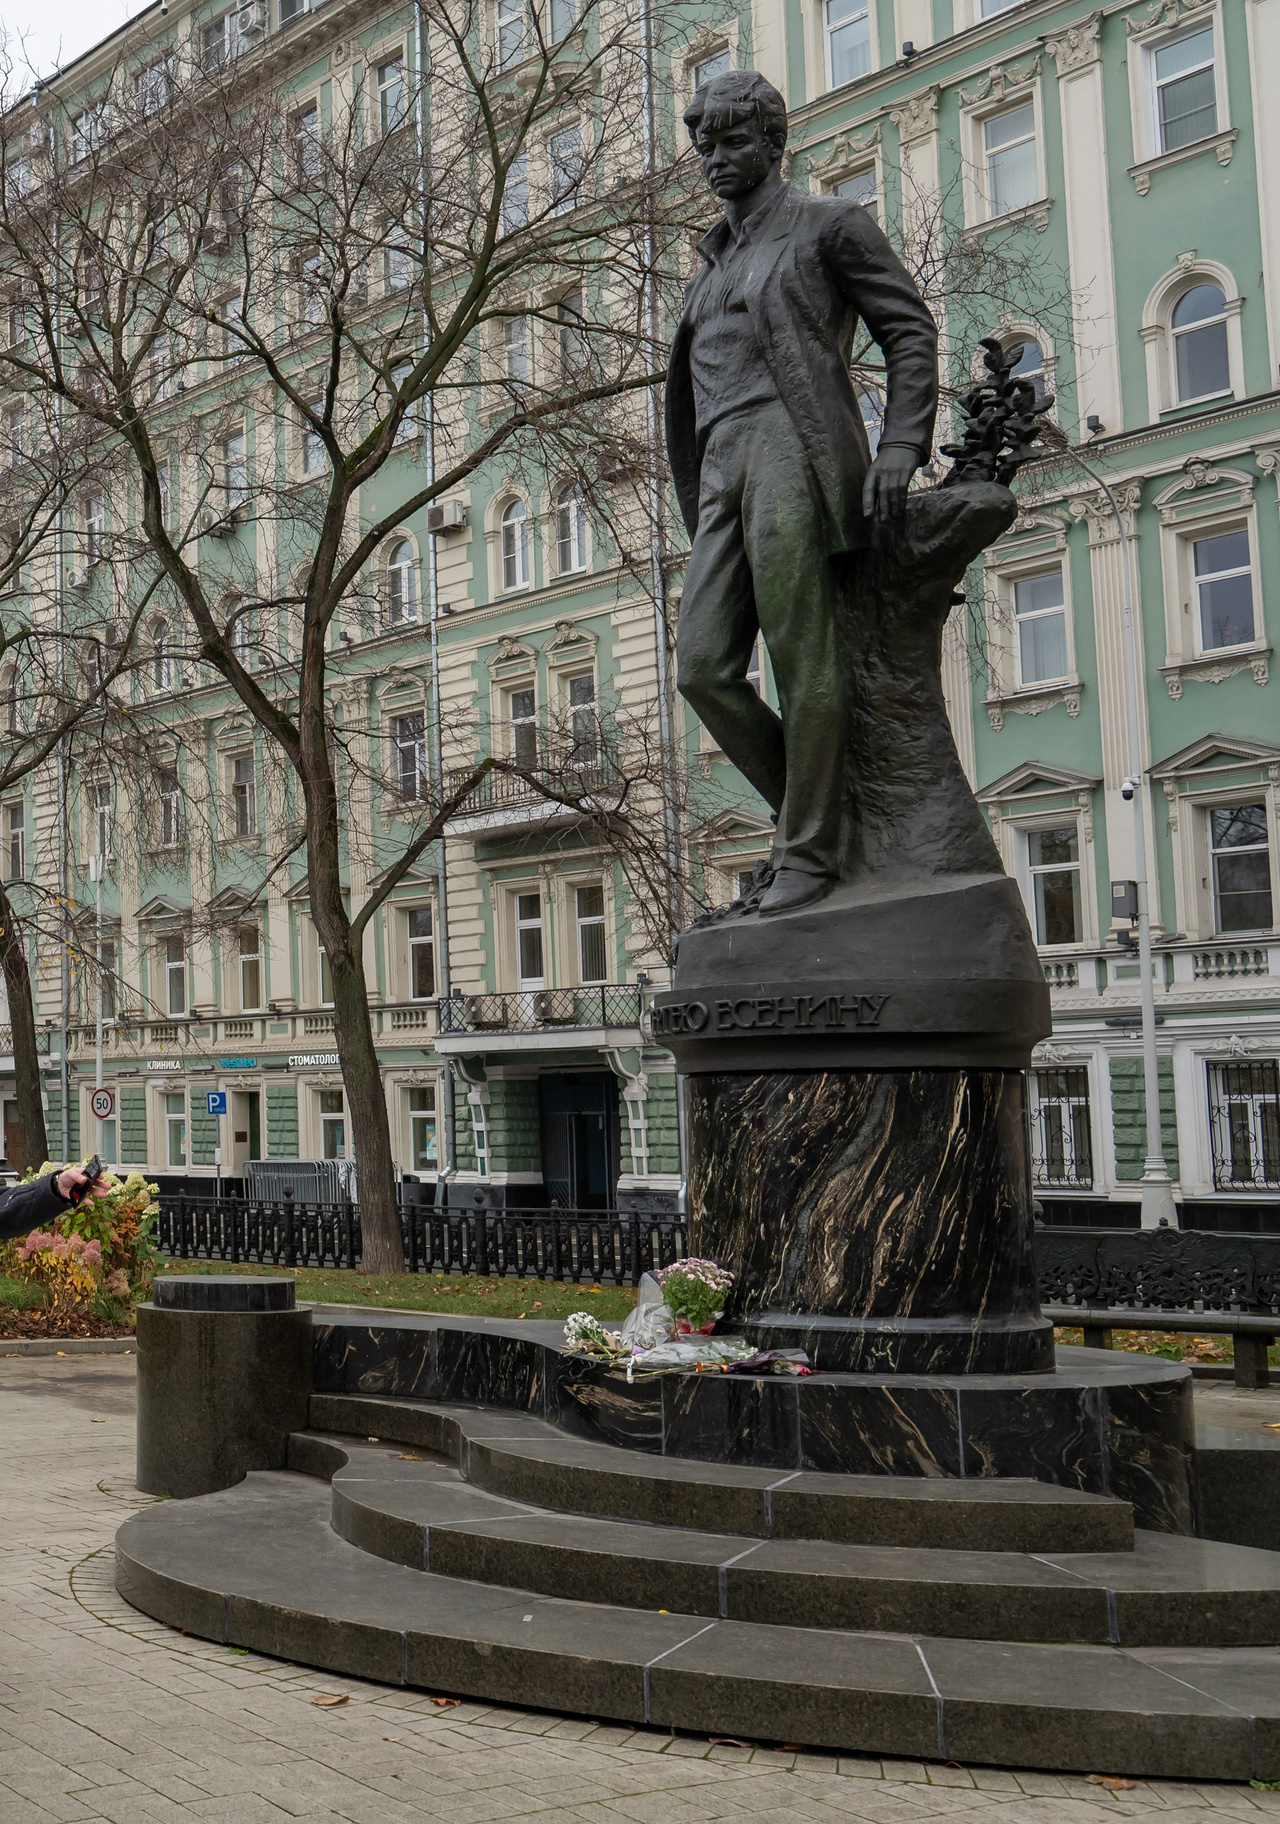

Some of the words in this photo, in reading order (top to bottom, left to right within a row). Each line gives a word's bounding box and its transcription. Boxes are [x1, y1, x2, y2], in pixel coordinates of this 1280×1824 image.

[714, 994, 890, 1031] ЕСЕНИНУ
[146, 1060, 181, 1070] КЛИНИКА
[288, 1053, 340, 1067] СТОМАТОЛОГ
[96, 1098, 109, 1110] 50
[208, 1094, 220, 1113] P
